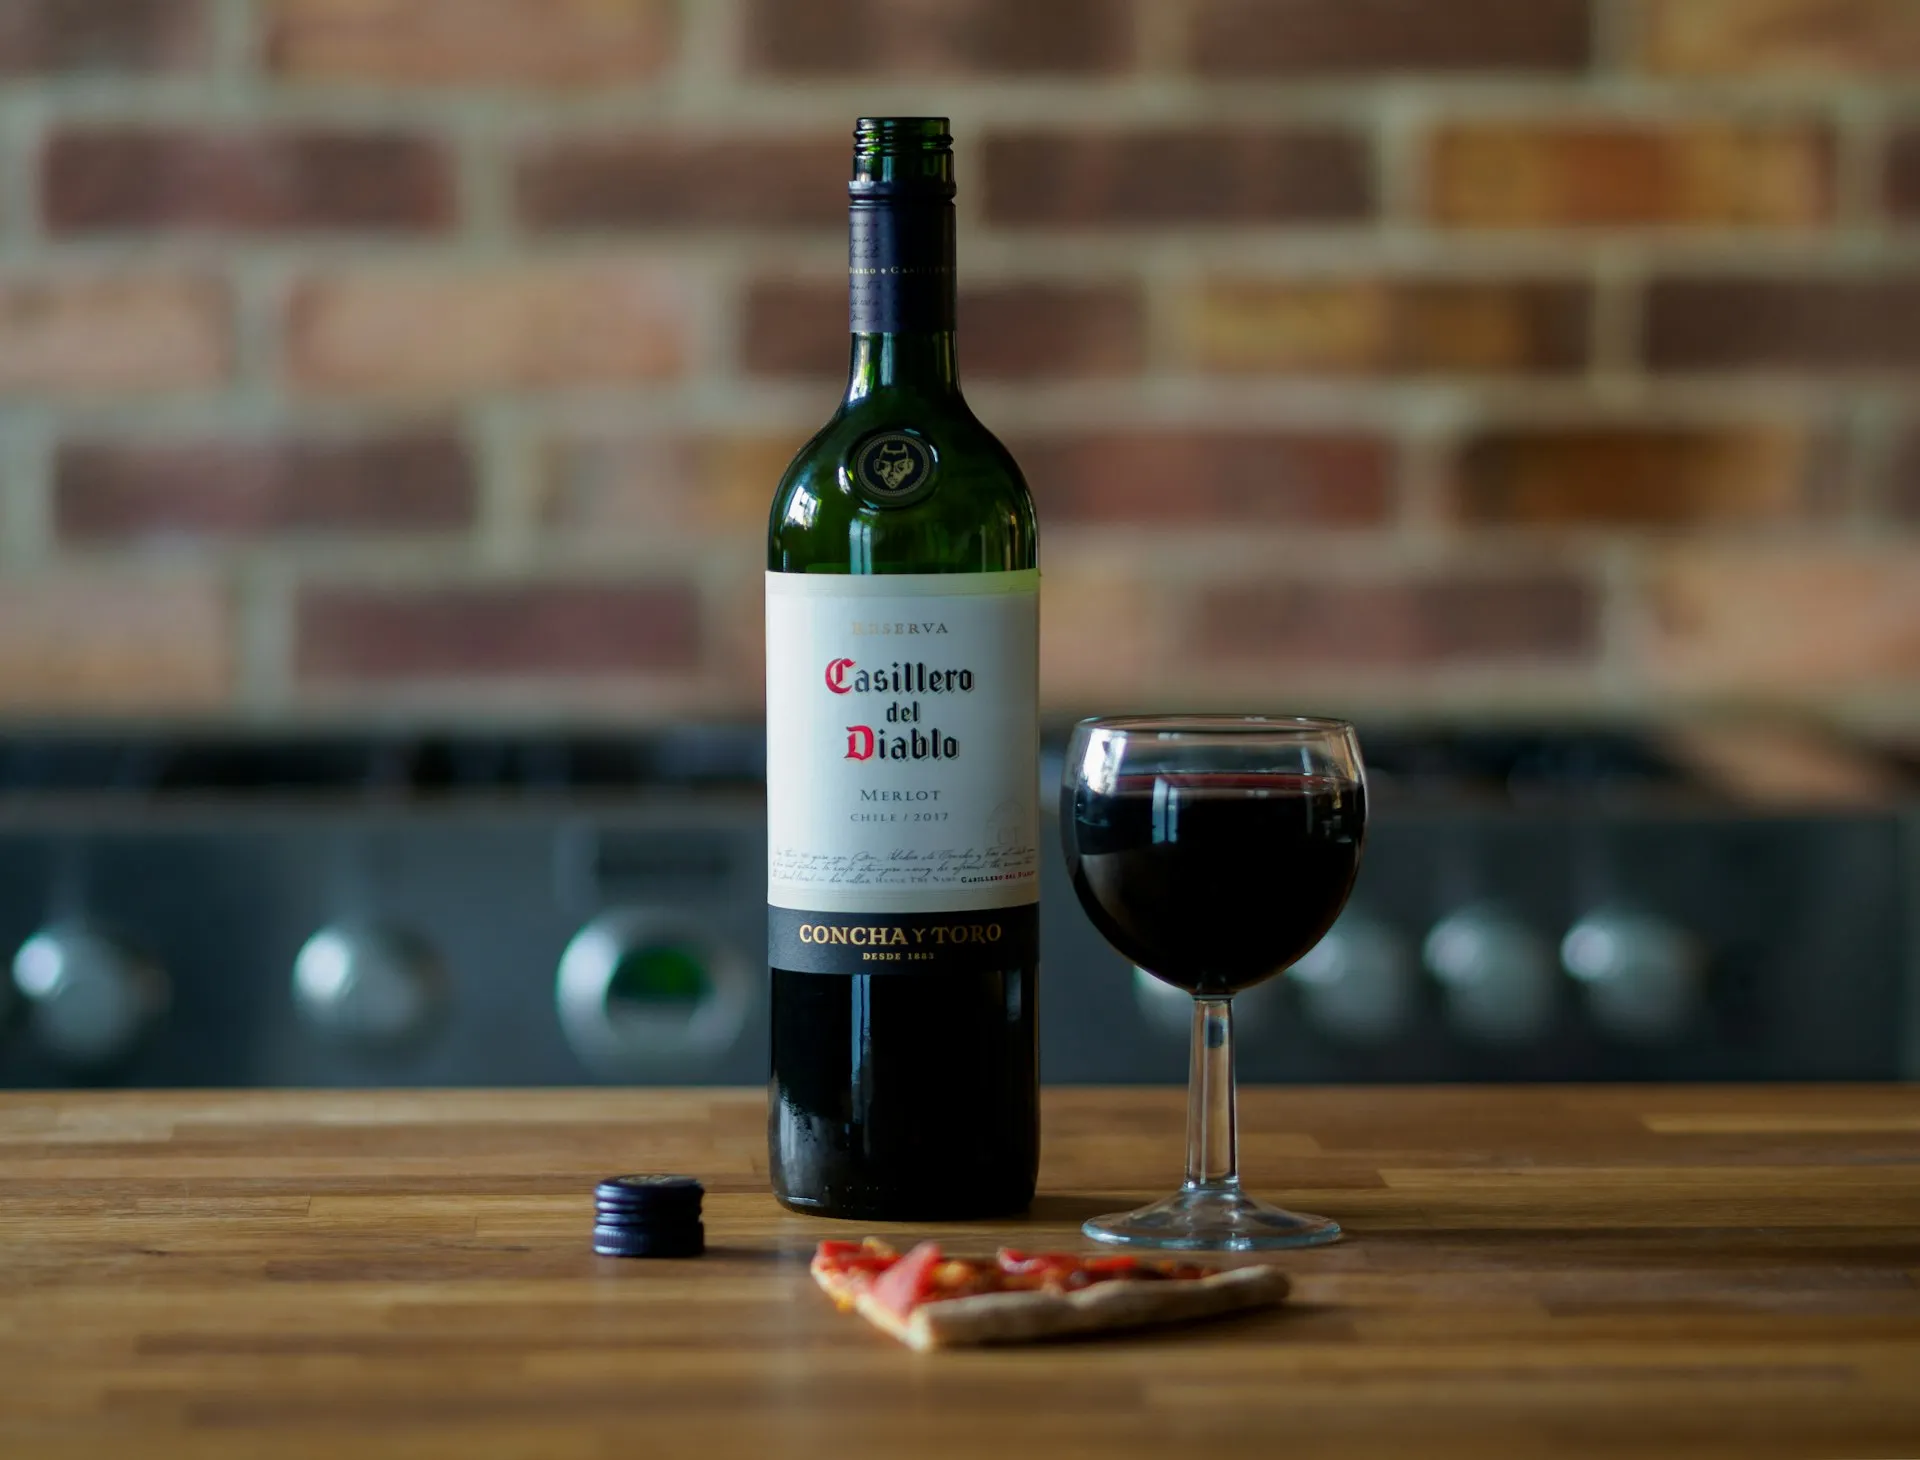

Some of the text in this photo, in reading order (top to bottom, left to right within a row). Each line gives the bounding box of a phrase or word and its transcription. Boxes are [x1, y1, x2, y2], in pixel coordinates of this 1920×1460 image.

[852, 622, 949, 636] RESERVA
[825, 657, 975, 695] Casillero
[886, 701, 920, 724] del
[844, 725, 960, 761] Diablo
[860, 789, 942, 802] MERLOT
[850, 812, 897, 822] CHILE
[913, 812, 949, 822] 2017
[799, 924, 908, 945] CONCHA
[930, 923, 1002, 944] TORO
[862, 952, 901, 961] DESDE
